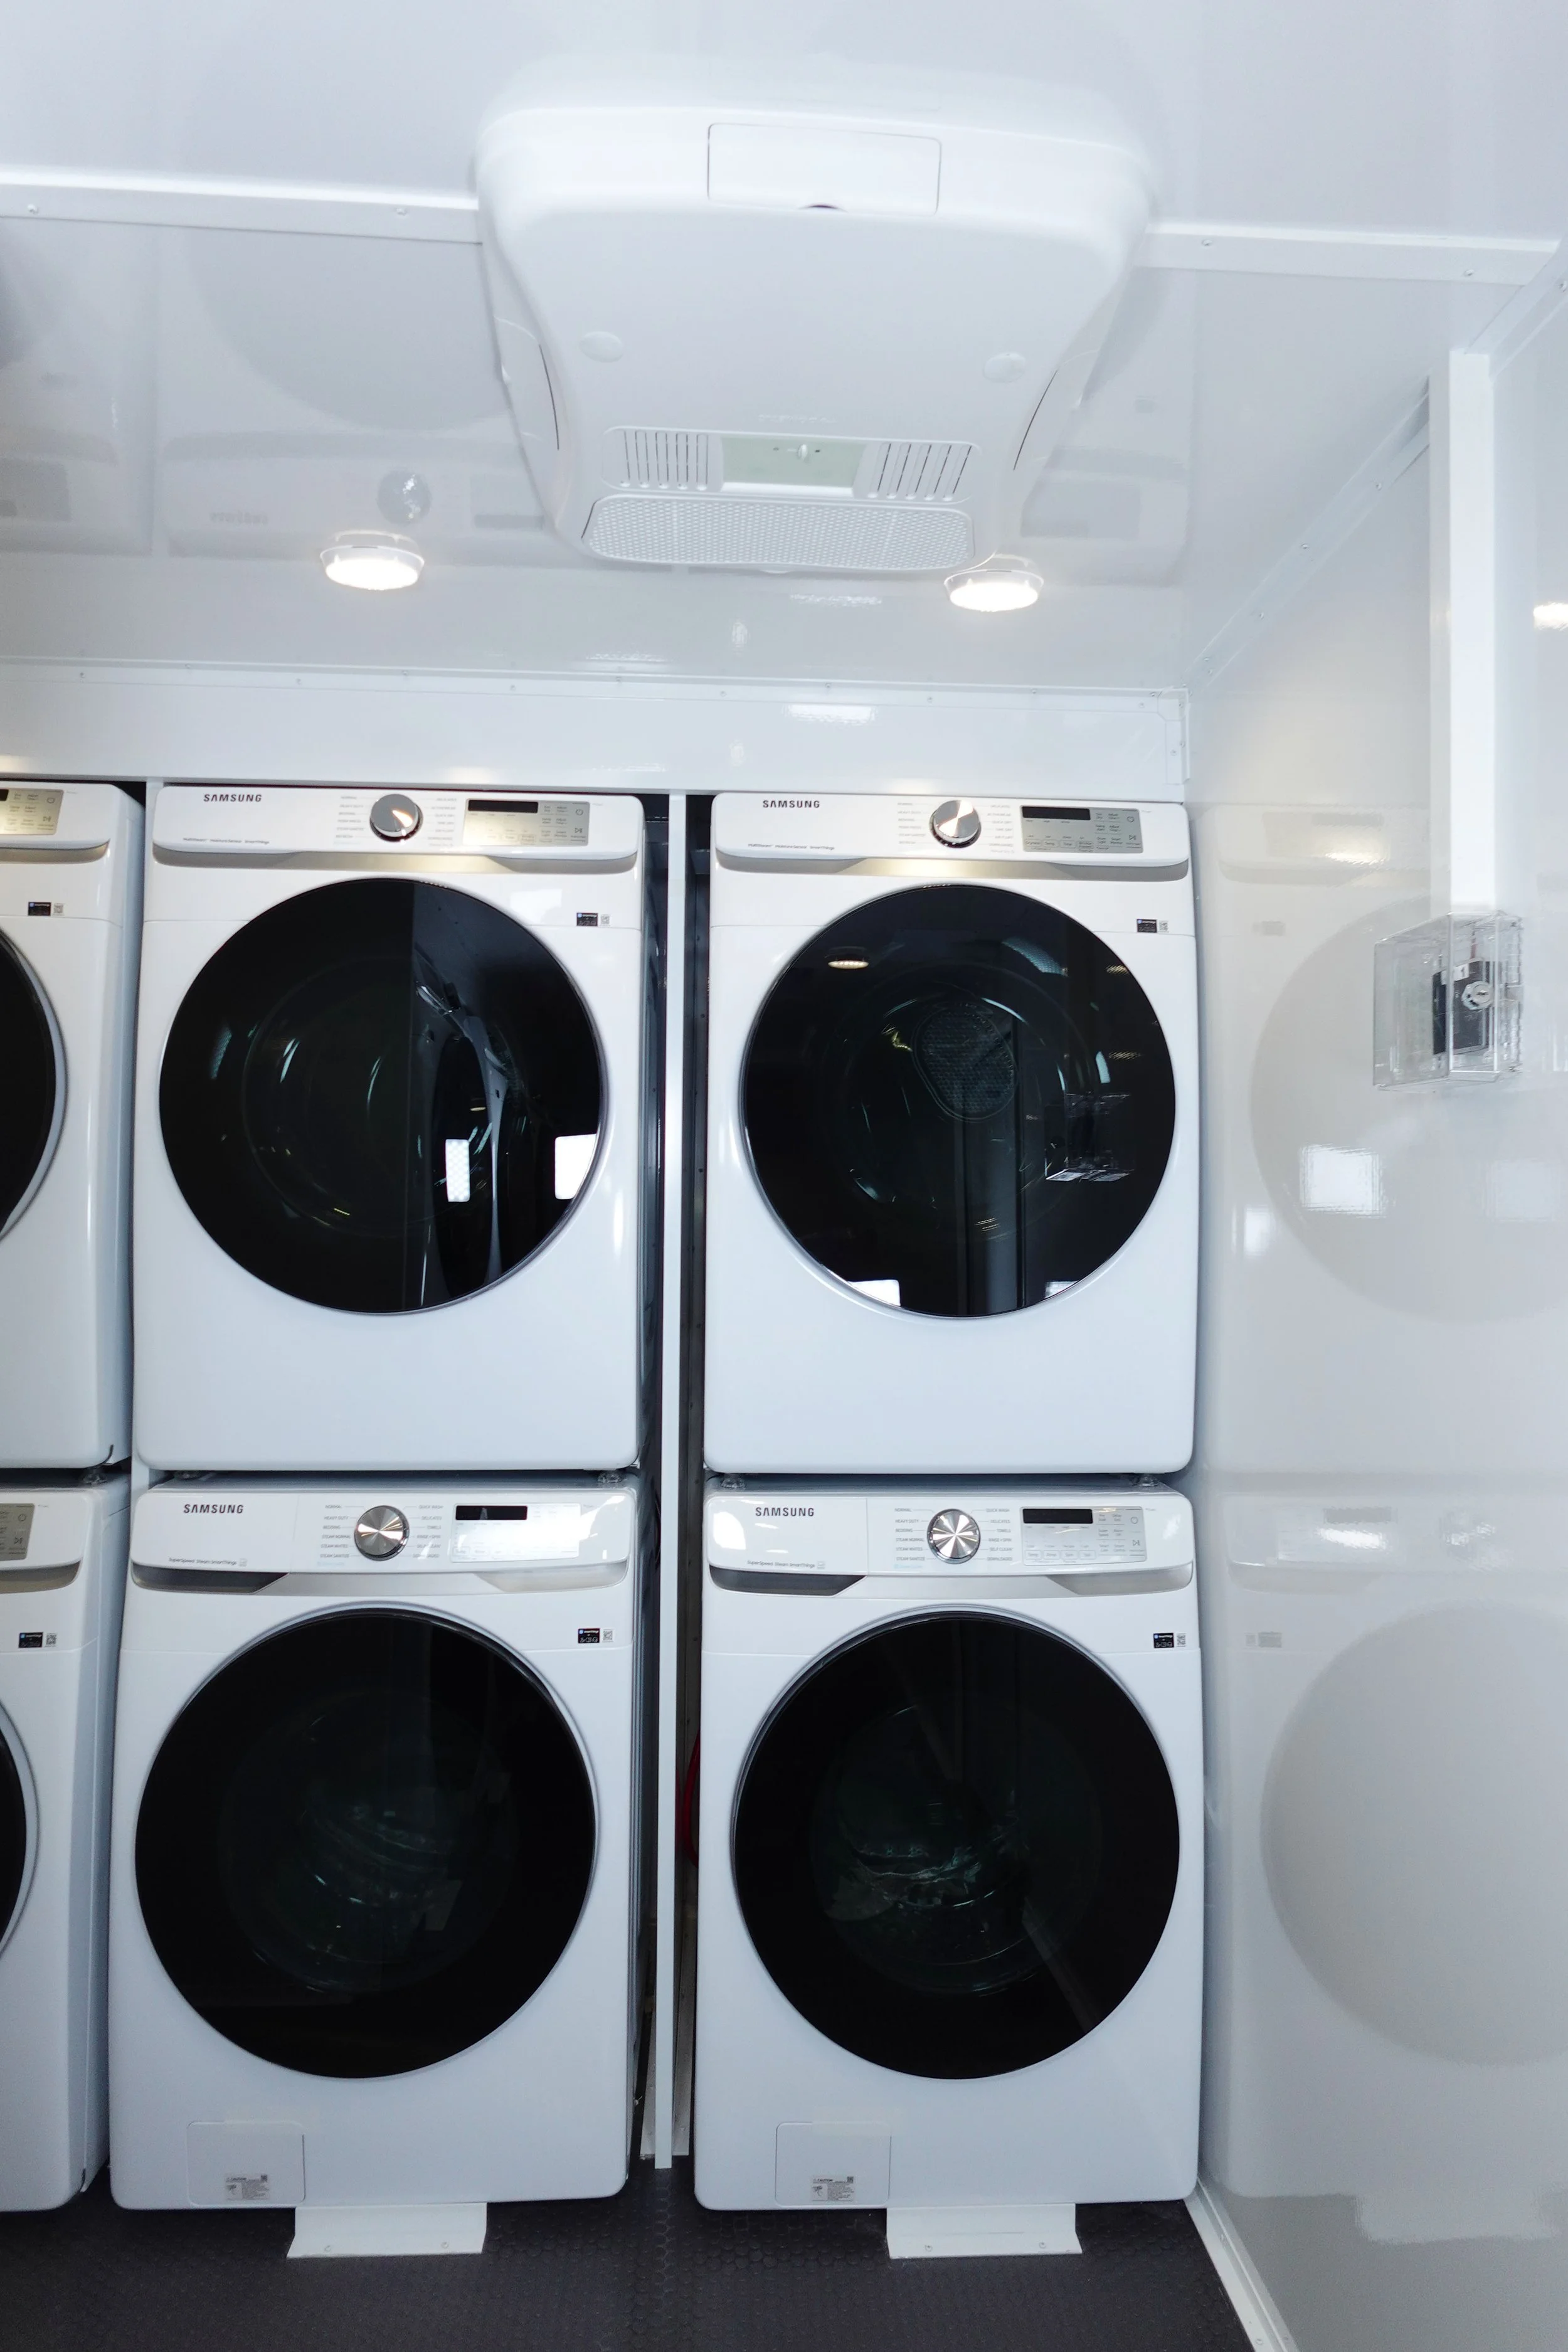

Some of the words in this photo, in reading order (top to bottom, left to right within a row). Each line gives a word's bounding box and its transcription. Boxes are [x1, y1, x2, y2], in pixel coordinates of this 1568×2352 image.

[204, 793, 262, 802] SAMSUNG
[763, 800, 820, 808] SAMSUNG
[184, 1504, 244, 1514] SAMSUNG
[755, 1507, 815, 1517] SAMSUNG
